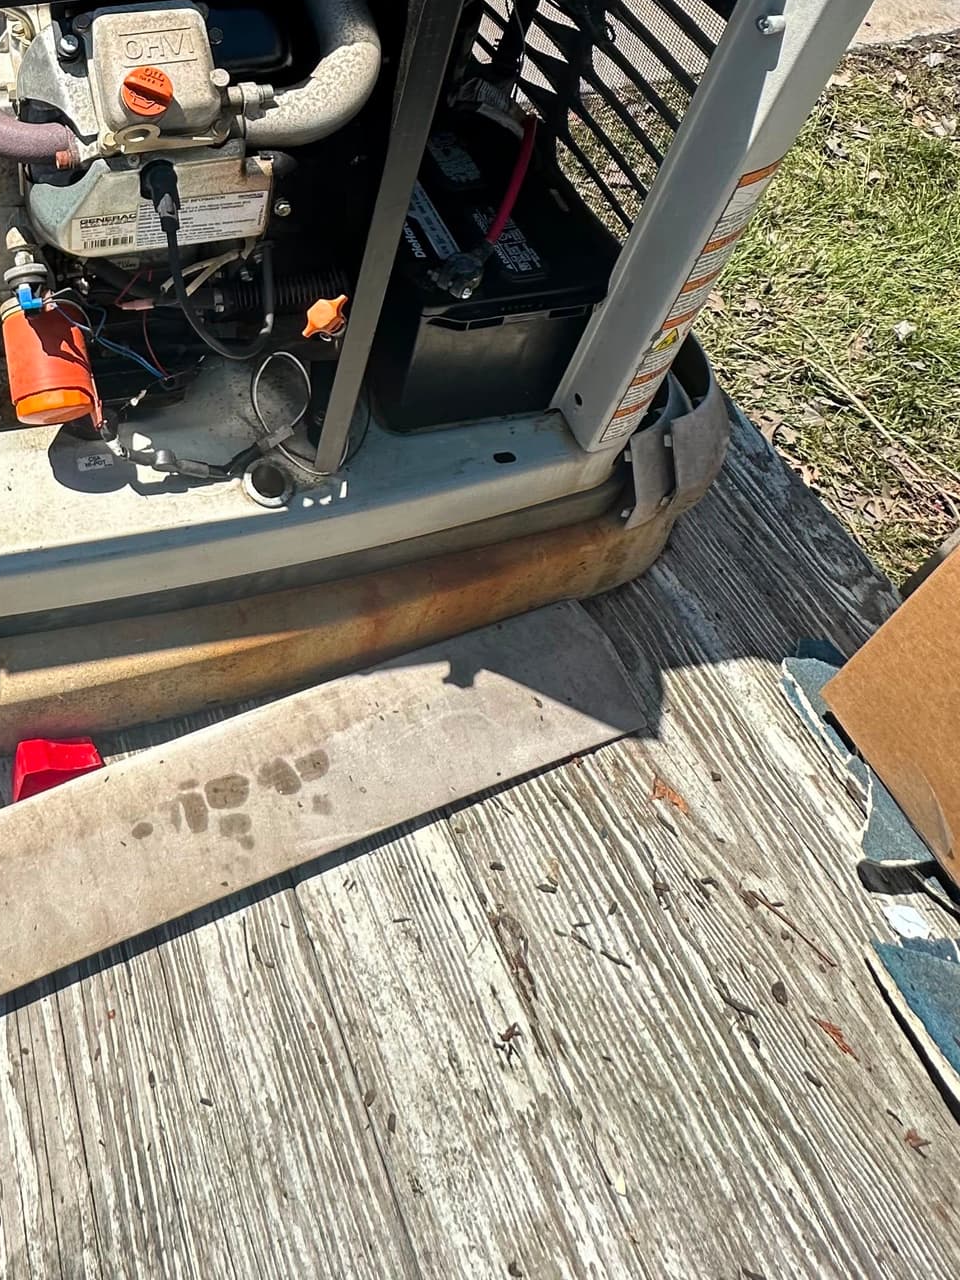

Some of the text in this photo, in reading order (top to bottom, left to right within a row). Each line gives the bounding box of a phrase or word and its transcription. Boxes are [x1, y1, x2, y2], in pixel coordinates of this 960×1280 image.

[123, 32, 195, 60] OHVI
[80, 213, 137, 225] GENERAC
[403, 221, 427, 258] DieHar
